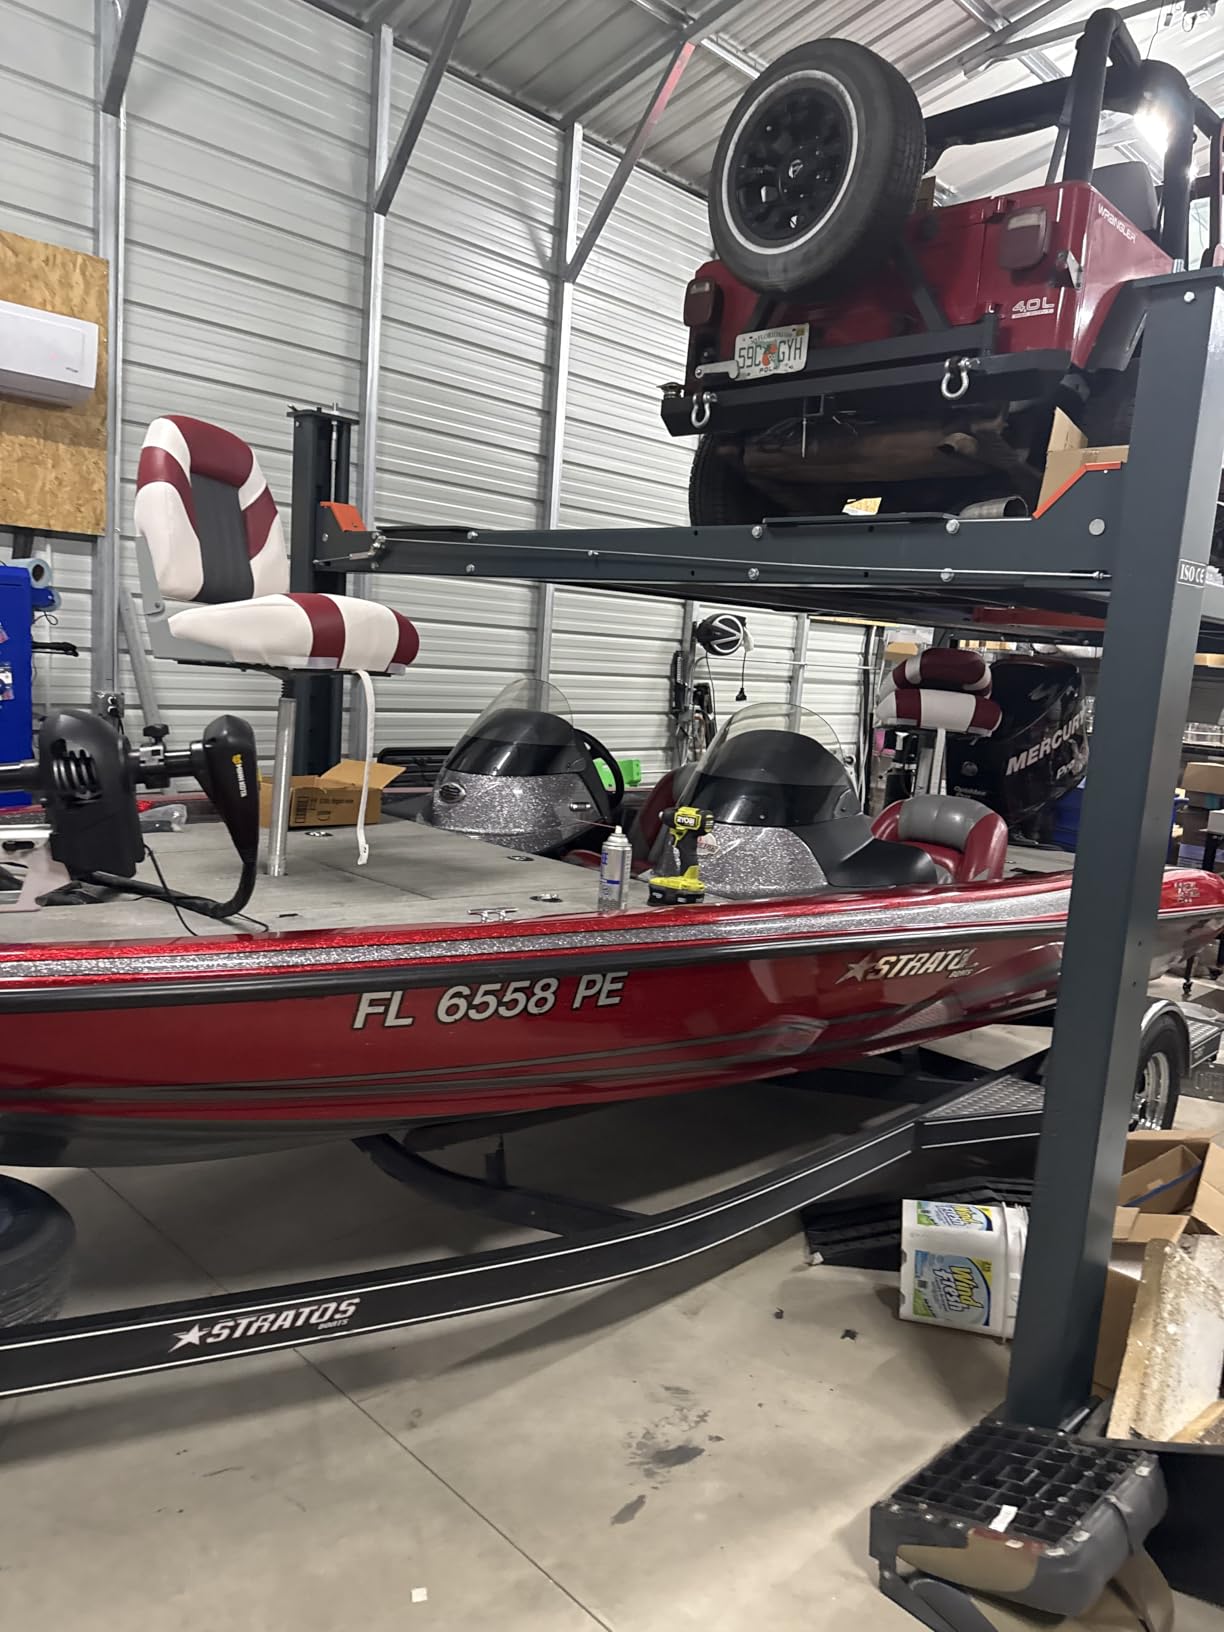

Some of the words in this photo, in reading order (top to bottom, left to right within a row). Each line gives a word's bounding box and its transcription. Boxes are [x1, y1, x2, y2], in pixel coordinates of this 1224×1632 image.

[1098, 203, 1136, 244] WRANGLER
[777, 336, 803, 362] GYH
[1180, 563, 1195, 582] ISO
[1006, 699, 1086, 776] MERCURY
[677, 816, 695, 826] RYOBI
[352, 990, 415, 1029] FL
[436, 977, 560, 1024] 6558
[572, 971, 629, 1009] PE
[932, 1267, 969, 1312] Fresh
[949, 1265, 984, 1309] Wind
[205, 1297, 361, 1344] STRATOS
